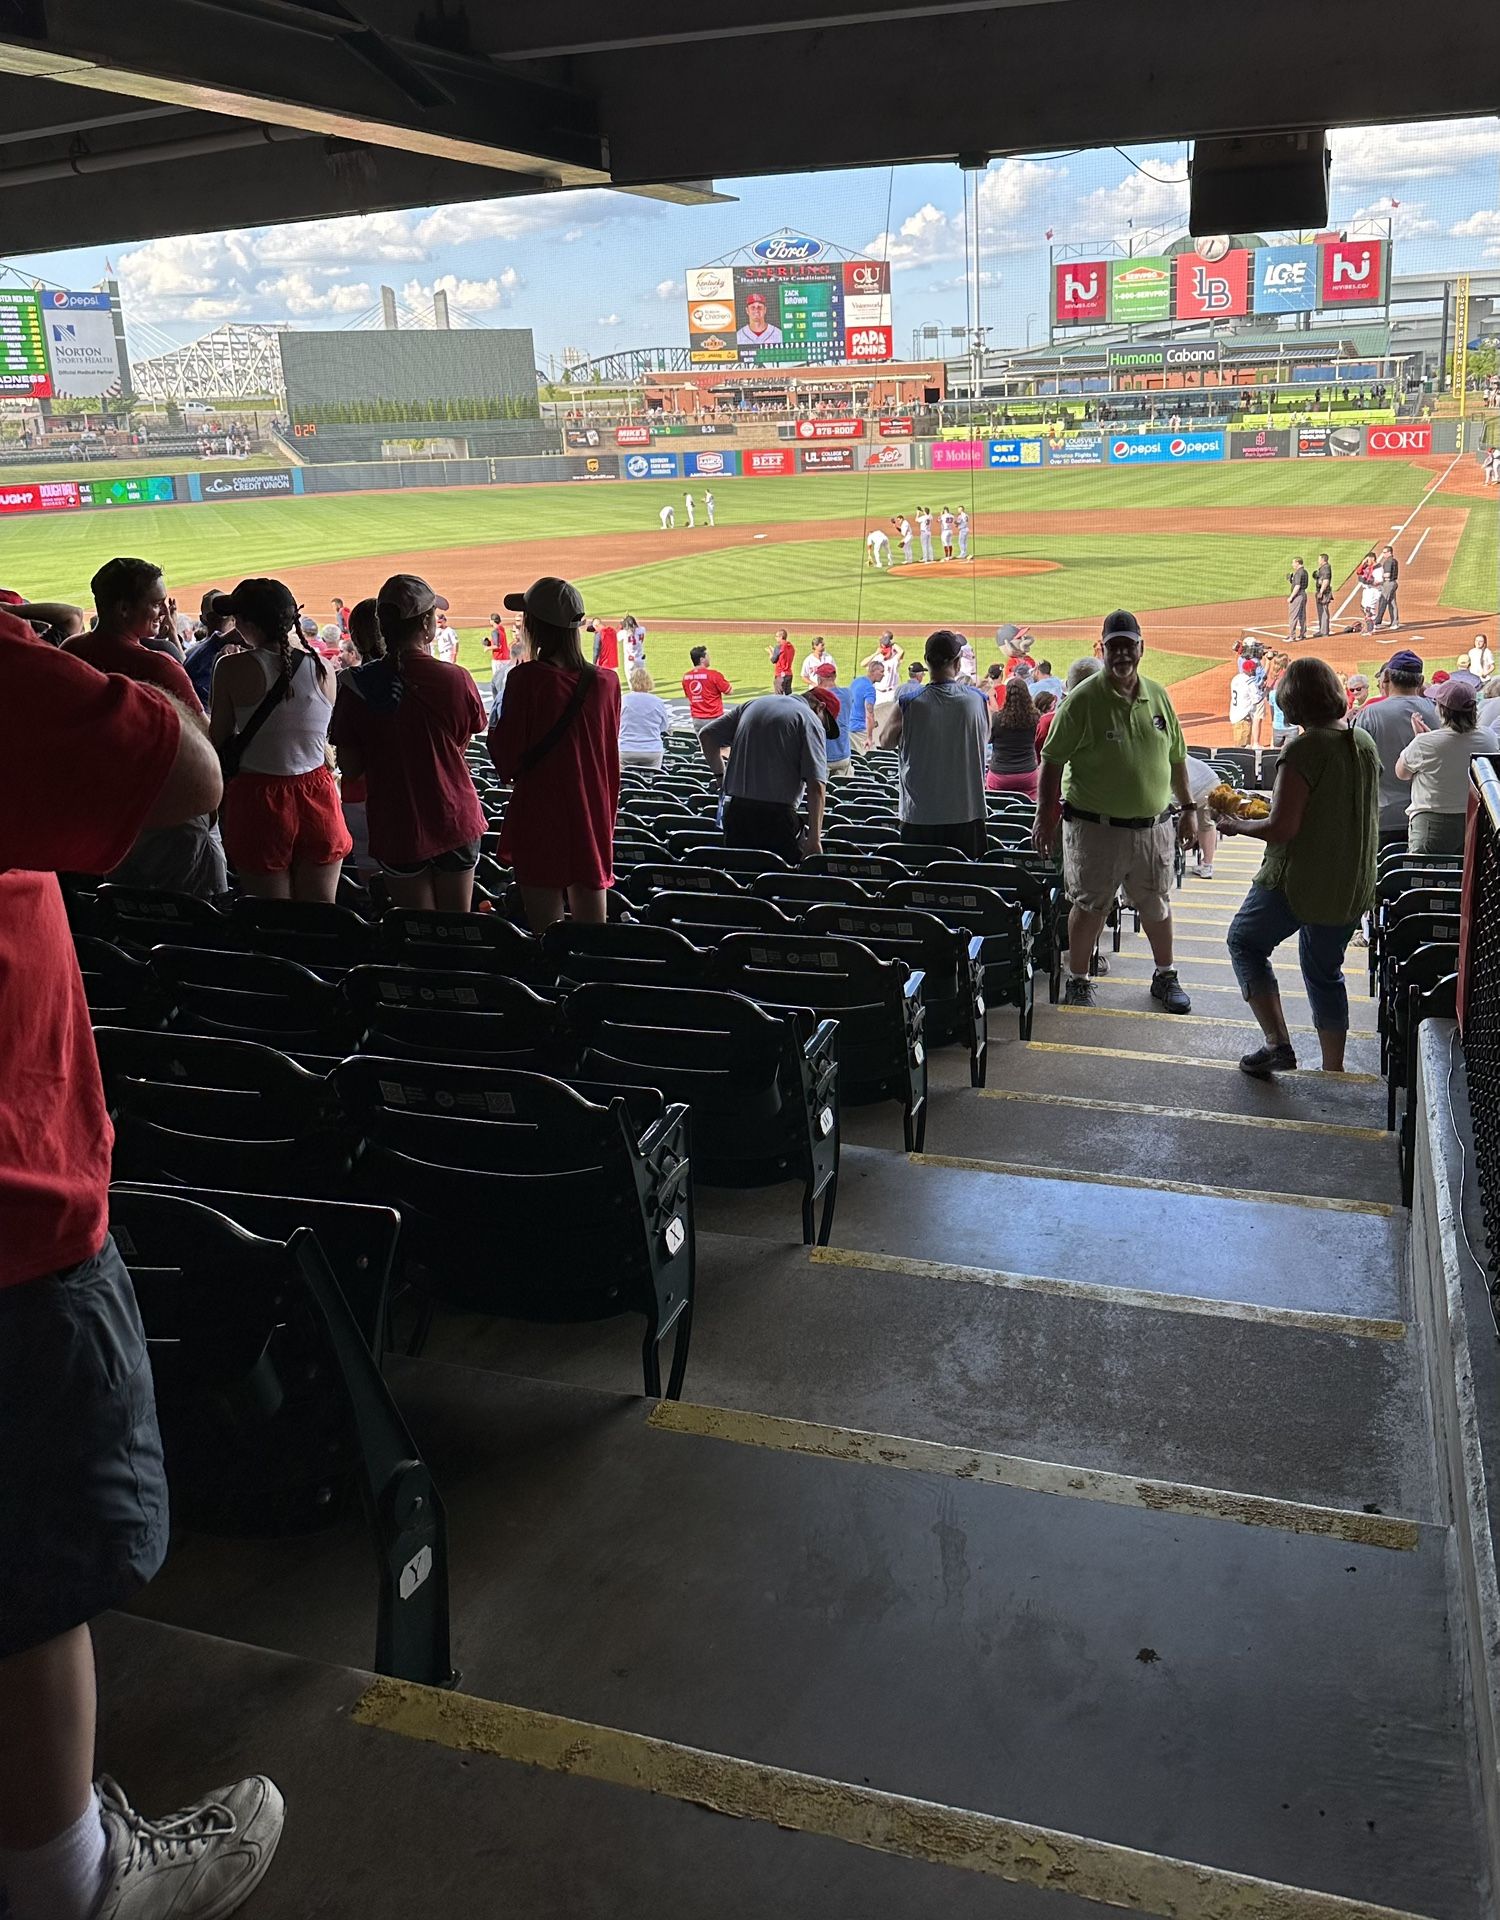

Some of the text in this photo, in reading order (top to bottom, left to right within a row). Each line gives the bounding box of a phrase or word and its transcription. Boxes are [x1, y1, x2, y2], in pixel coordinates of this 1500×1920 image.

[766, 239, 809, 258] Ford
[746, 265, 830, 278] STERLING
[1264, 262, 1307, 286] LG&E
[70, 296, 99, 308] pepsi
[852, 330, 886, 346] PAPA
[56, 346, 101, 356] NORTON
[851, 344, 886, 356] JOHNS
[1110, 348, 1215, 366] Humana Cabana
[744, 377, 790, 385] TAPHOUSE
[294, 424, 316, 436] 0:29
[618, 428, 646, 437] MIKE'S
[1370, 431, 1430, 449] CORT
[1130, 442, 1161, 455] pepsi
[1187, 441, 1219, 453] pepsi
[752, 456, 784, 466] BEEF
[934, 450, 980, 461] T Mobile
[991, 455, 1019, 463] PAID
[233, 475, 289, 484] COMMONWEALTH
[234, 480, 289, 491] CREDIT UNION
[670, 1224, 680, 1246] X
[409, 1554, 422, 1585] Y
